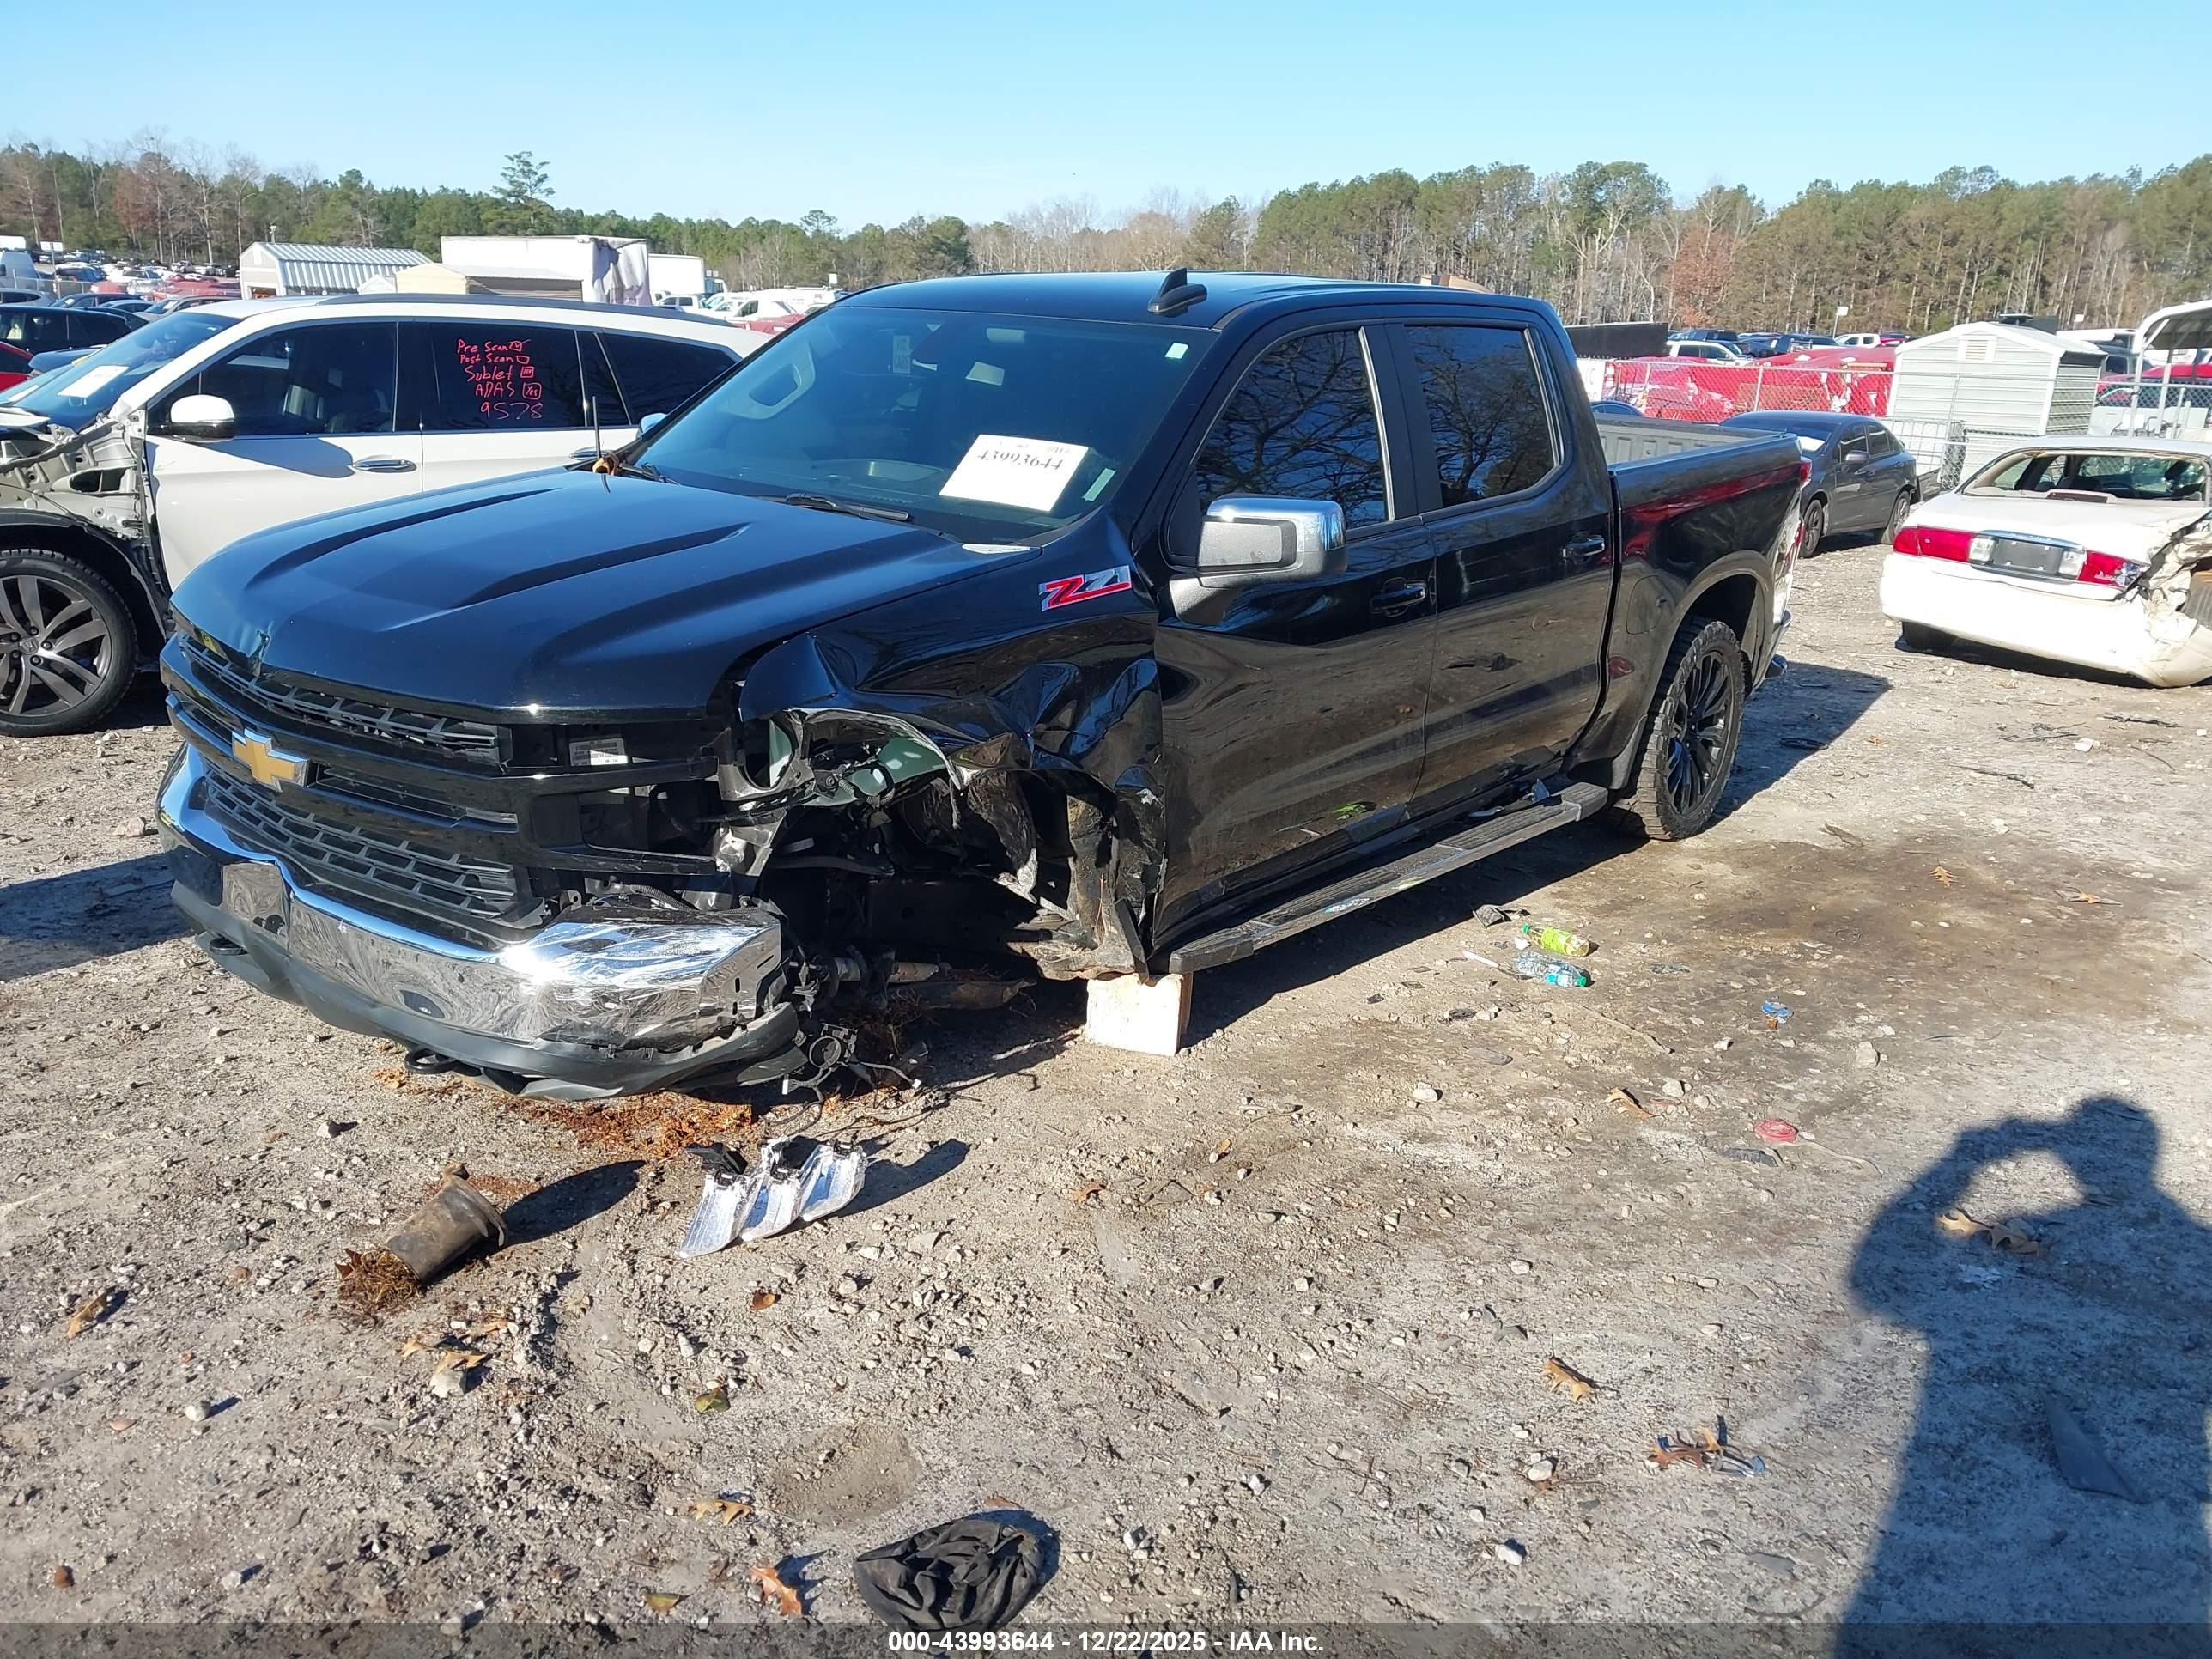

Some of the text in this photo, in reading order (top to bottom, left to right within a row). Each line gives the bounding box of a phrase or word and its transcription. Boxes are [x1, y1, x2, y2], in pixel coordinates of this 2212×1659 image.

[457, 338, 509, 354] Pre Scan
[460, 353, 514, 364] Post Scan
[465, 365, 514, 382] Sublet
[476, 381, 515, 398] ADAS
[481, 401, 543, 420] 9578
[977, 449, 1063, 471] 43993644
[1038, 565, 1132, 611] Z71
